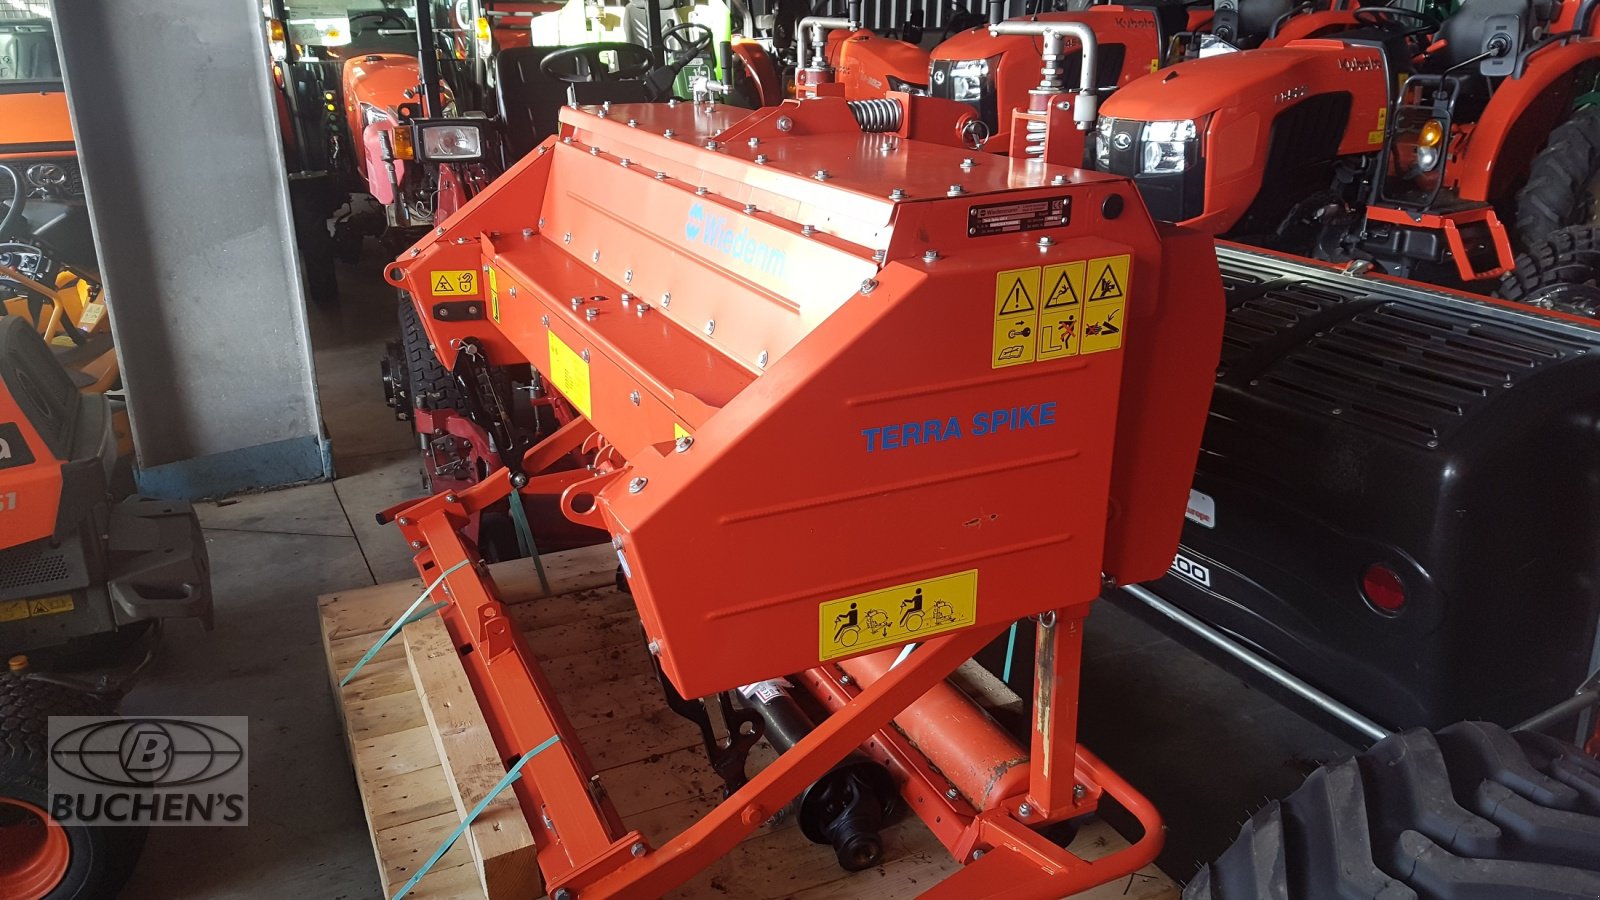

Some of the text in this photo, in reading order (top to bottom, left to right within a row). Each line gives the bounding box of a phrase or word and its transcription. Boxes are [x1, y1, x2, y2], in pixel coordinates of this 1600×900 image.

[861, 402, 1057, 452] TERRA SPIKE
[1187, 507, 1210, 522] urope
[1176, 556, 1207, 582] 00
